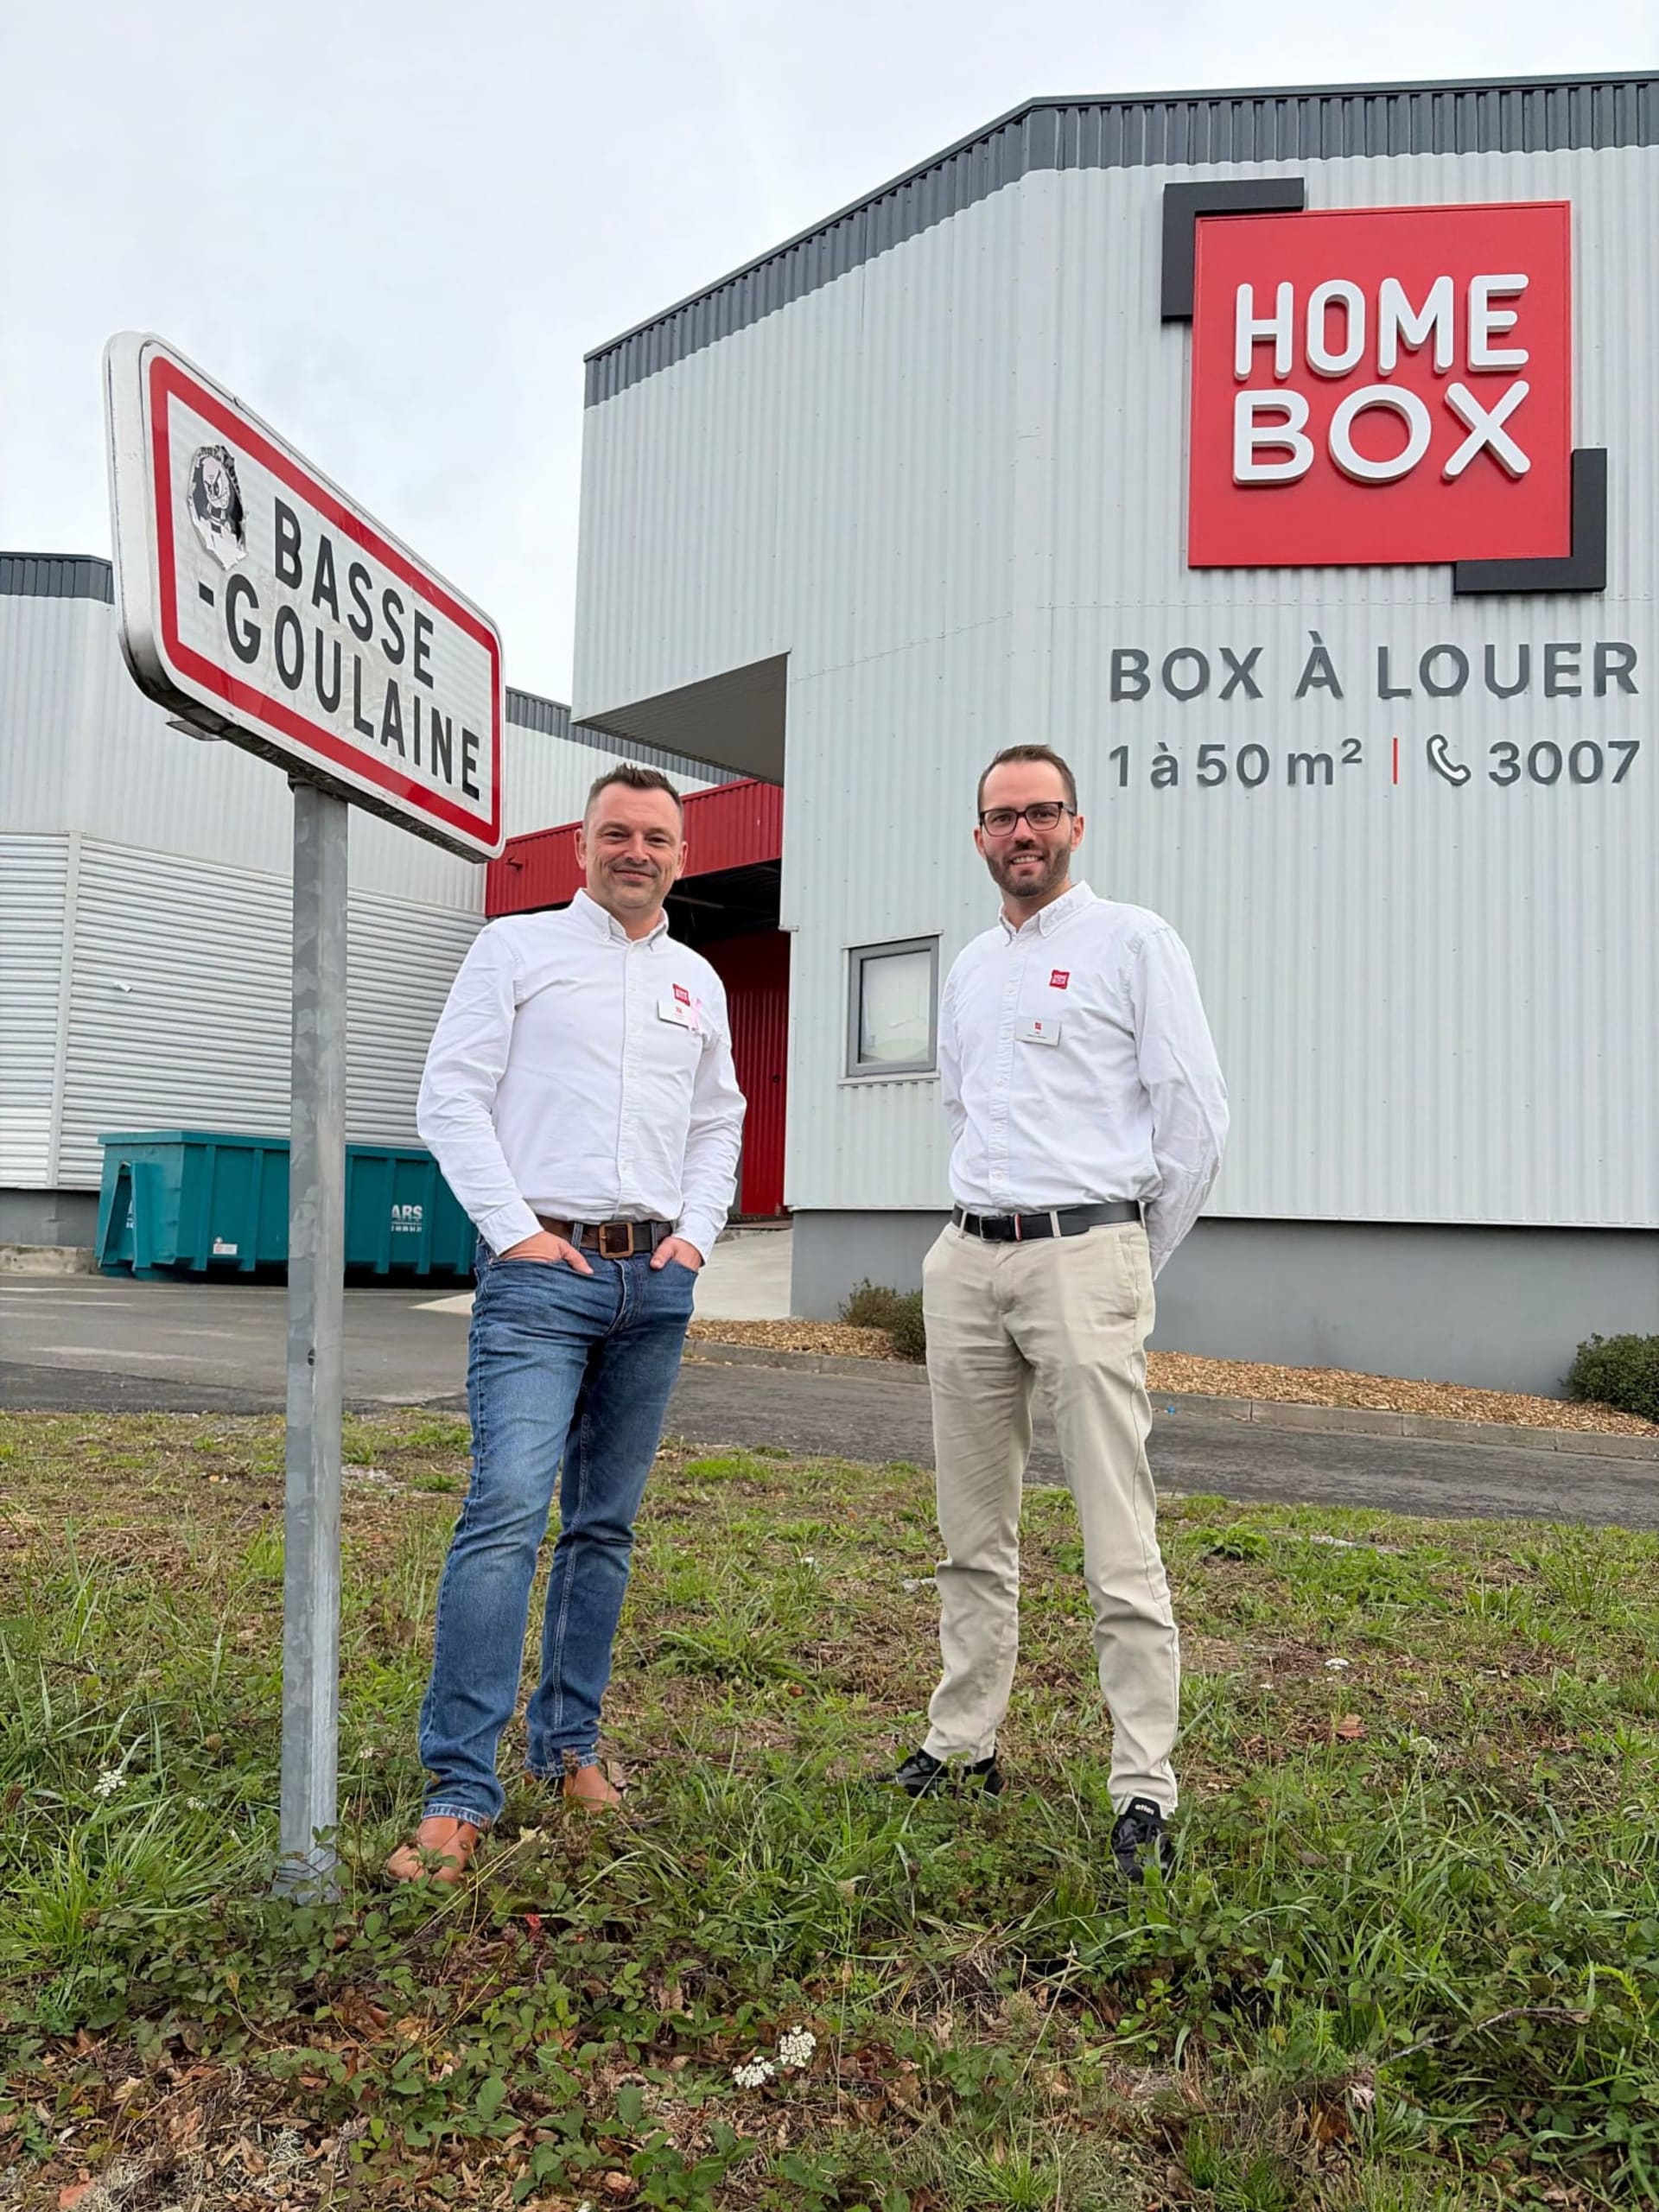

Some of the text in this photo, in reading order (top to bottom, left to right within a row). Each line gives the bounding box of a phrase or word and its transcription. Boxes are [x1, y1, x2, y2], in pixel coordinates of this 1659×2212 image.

[1235, 275, 1529, 380] HOME
[1233, 380, 1530, 484] BOX
[275, 497, 434, 690] BASSE
[199, 574, 480, 801] -GOULAINE
[1110, 630, 1639, 702] BOX À LOUER
[1109, 738, 1640, 788] 1 à 50 m² 3007
[391, 1205, 423, 1220] ARS
